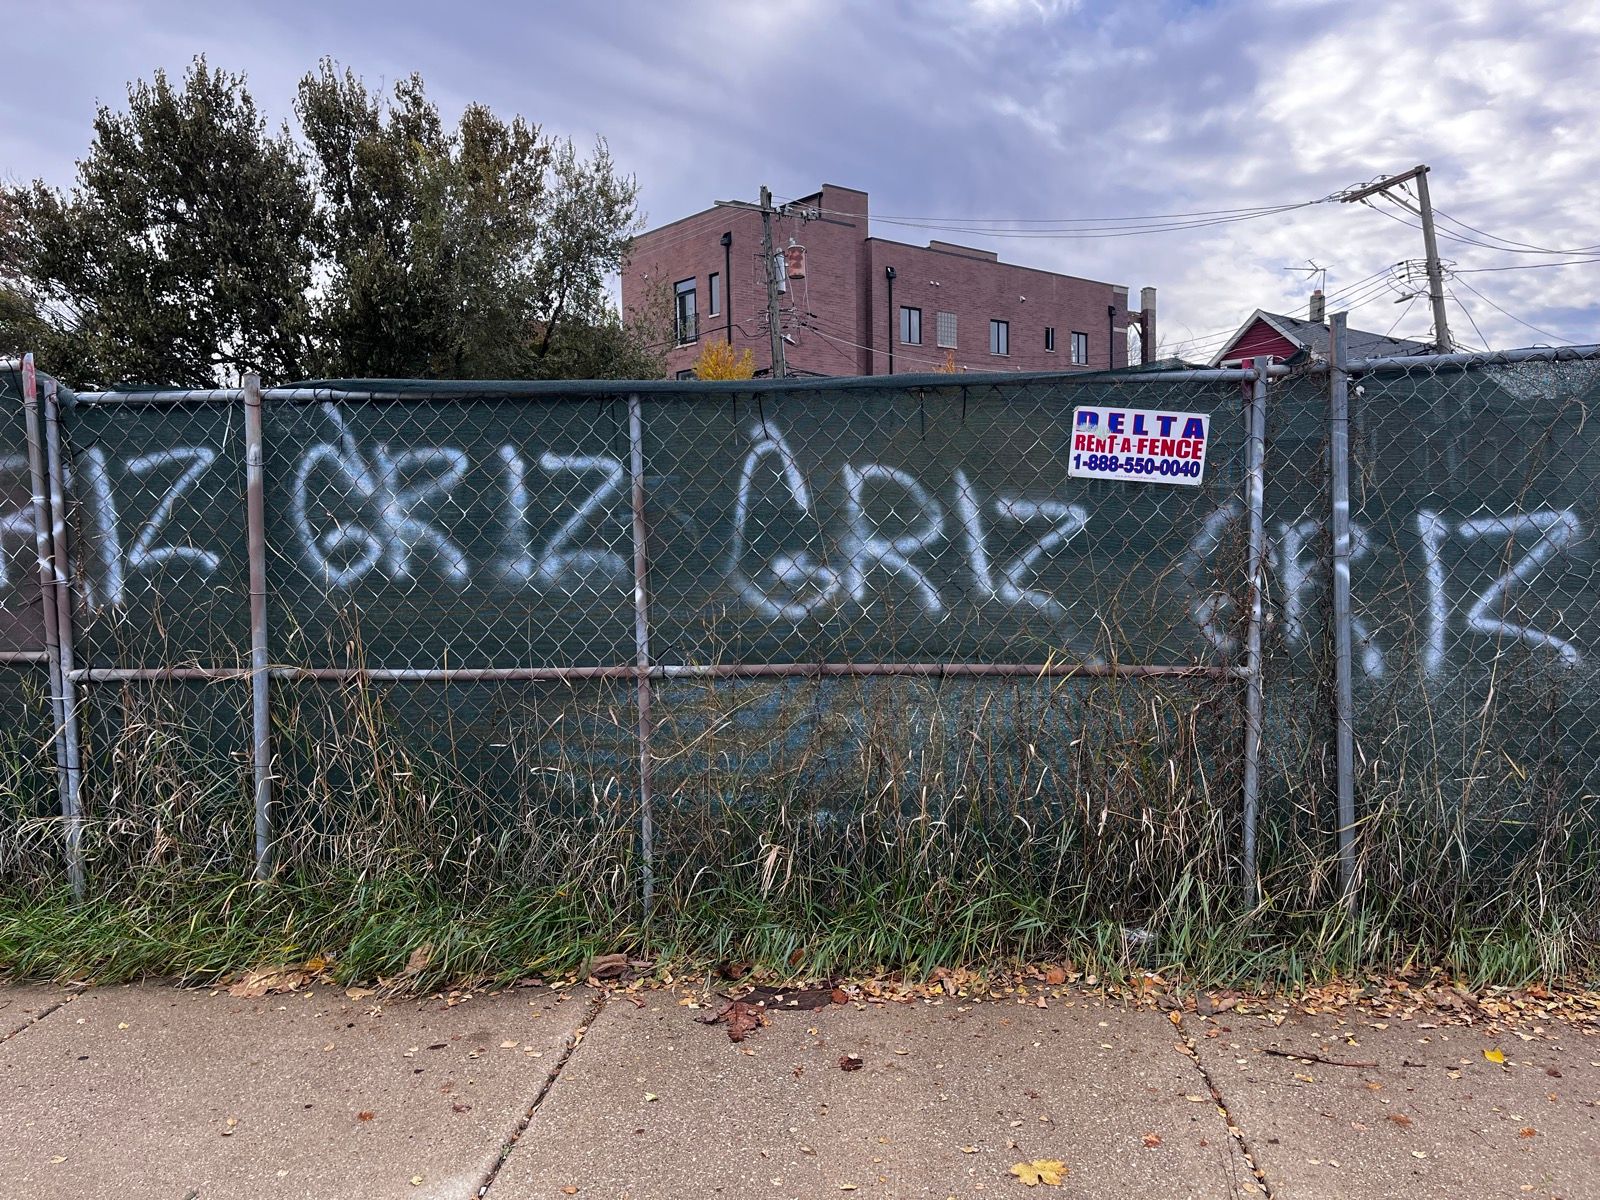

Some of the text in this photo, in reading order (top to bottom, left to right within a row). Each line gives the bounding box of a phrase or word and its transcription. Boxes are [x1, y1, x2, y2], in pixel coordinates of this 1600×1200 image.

[1076, 411, 1204, 439] DELTA
[1075, 434, 1203, 460] RENT-A-FENCE
[1073, 453, 1200, 478] 1-888-550-0040
[728, 419, 1090, 622] GRIZ
